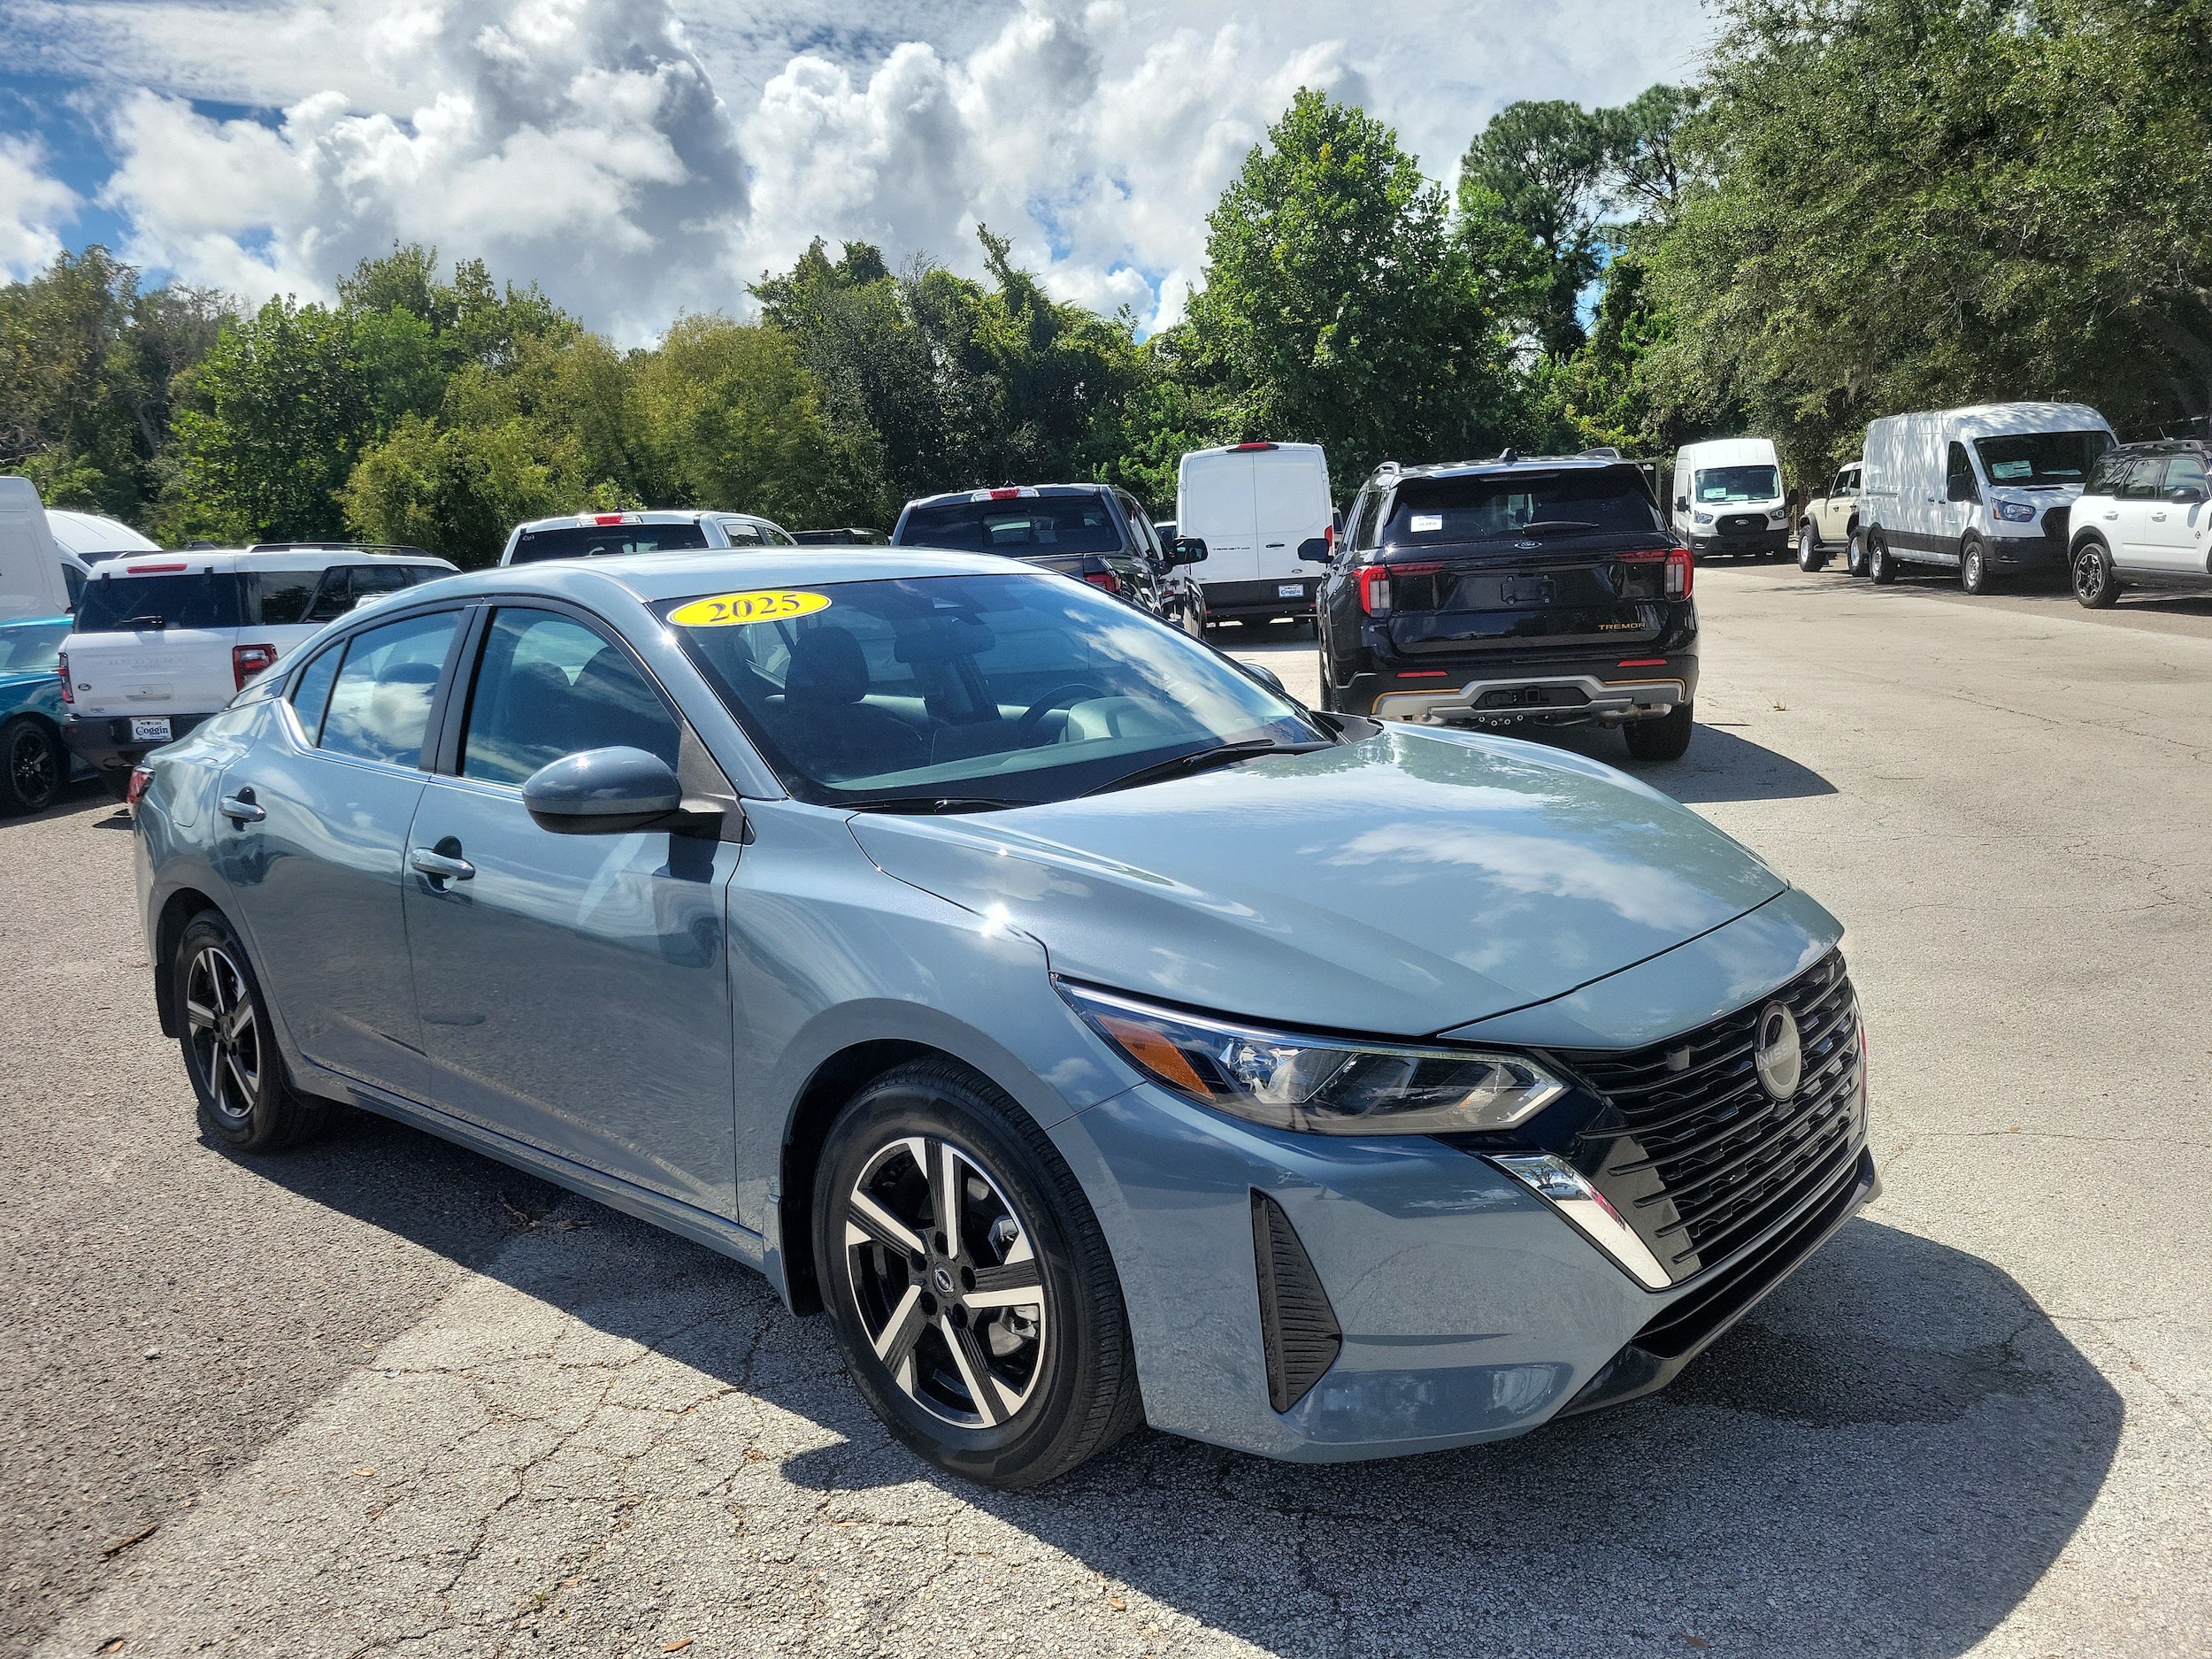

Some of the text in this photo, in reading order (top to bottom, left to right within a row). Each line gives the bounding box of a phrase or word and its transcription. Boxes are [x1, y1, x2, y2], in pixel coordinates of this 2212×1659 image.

[707, 595, 800, 622] 2025
[1598, 622, 1646, 631] TREMOR
[135, 726, 168, 736] Coggin
